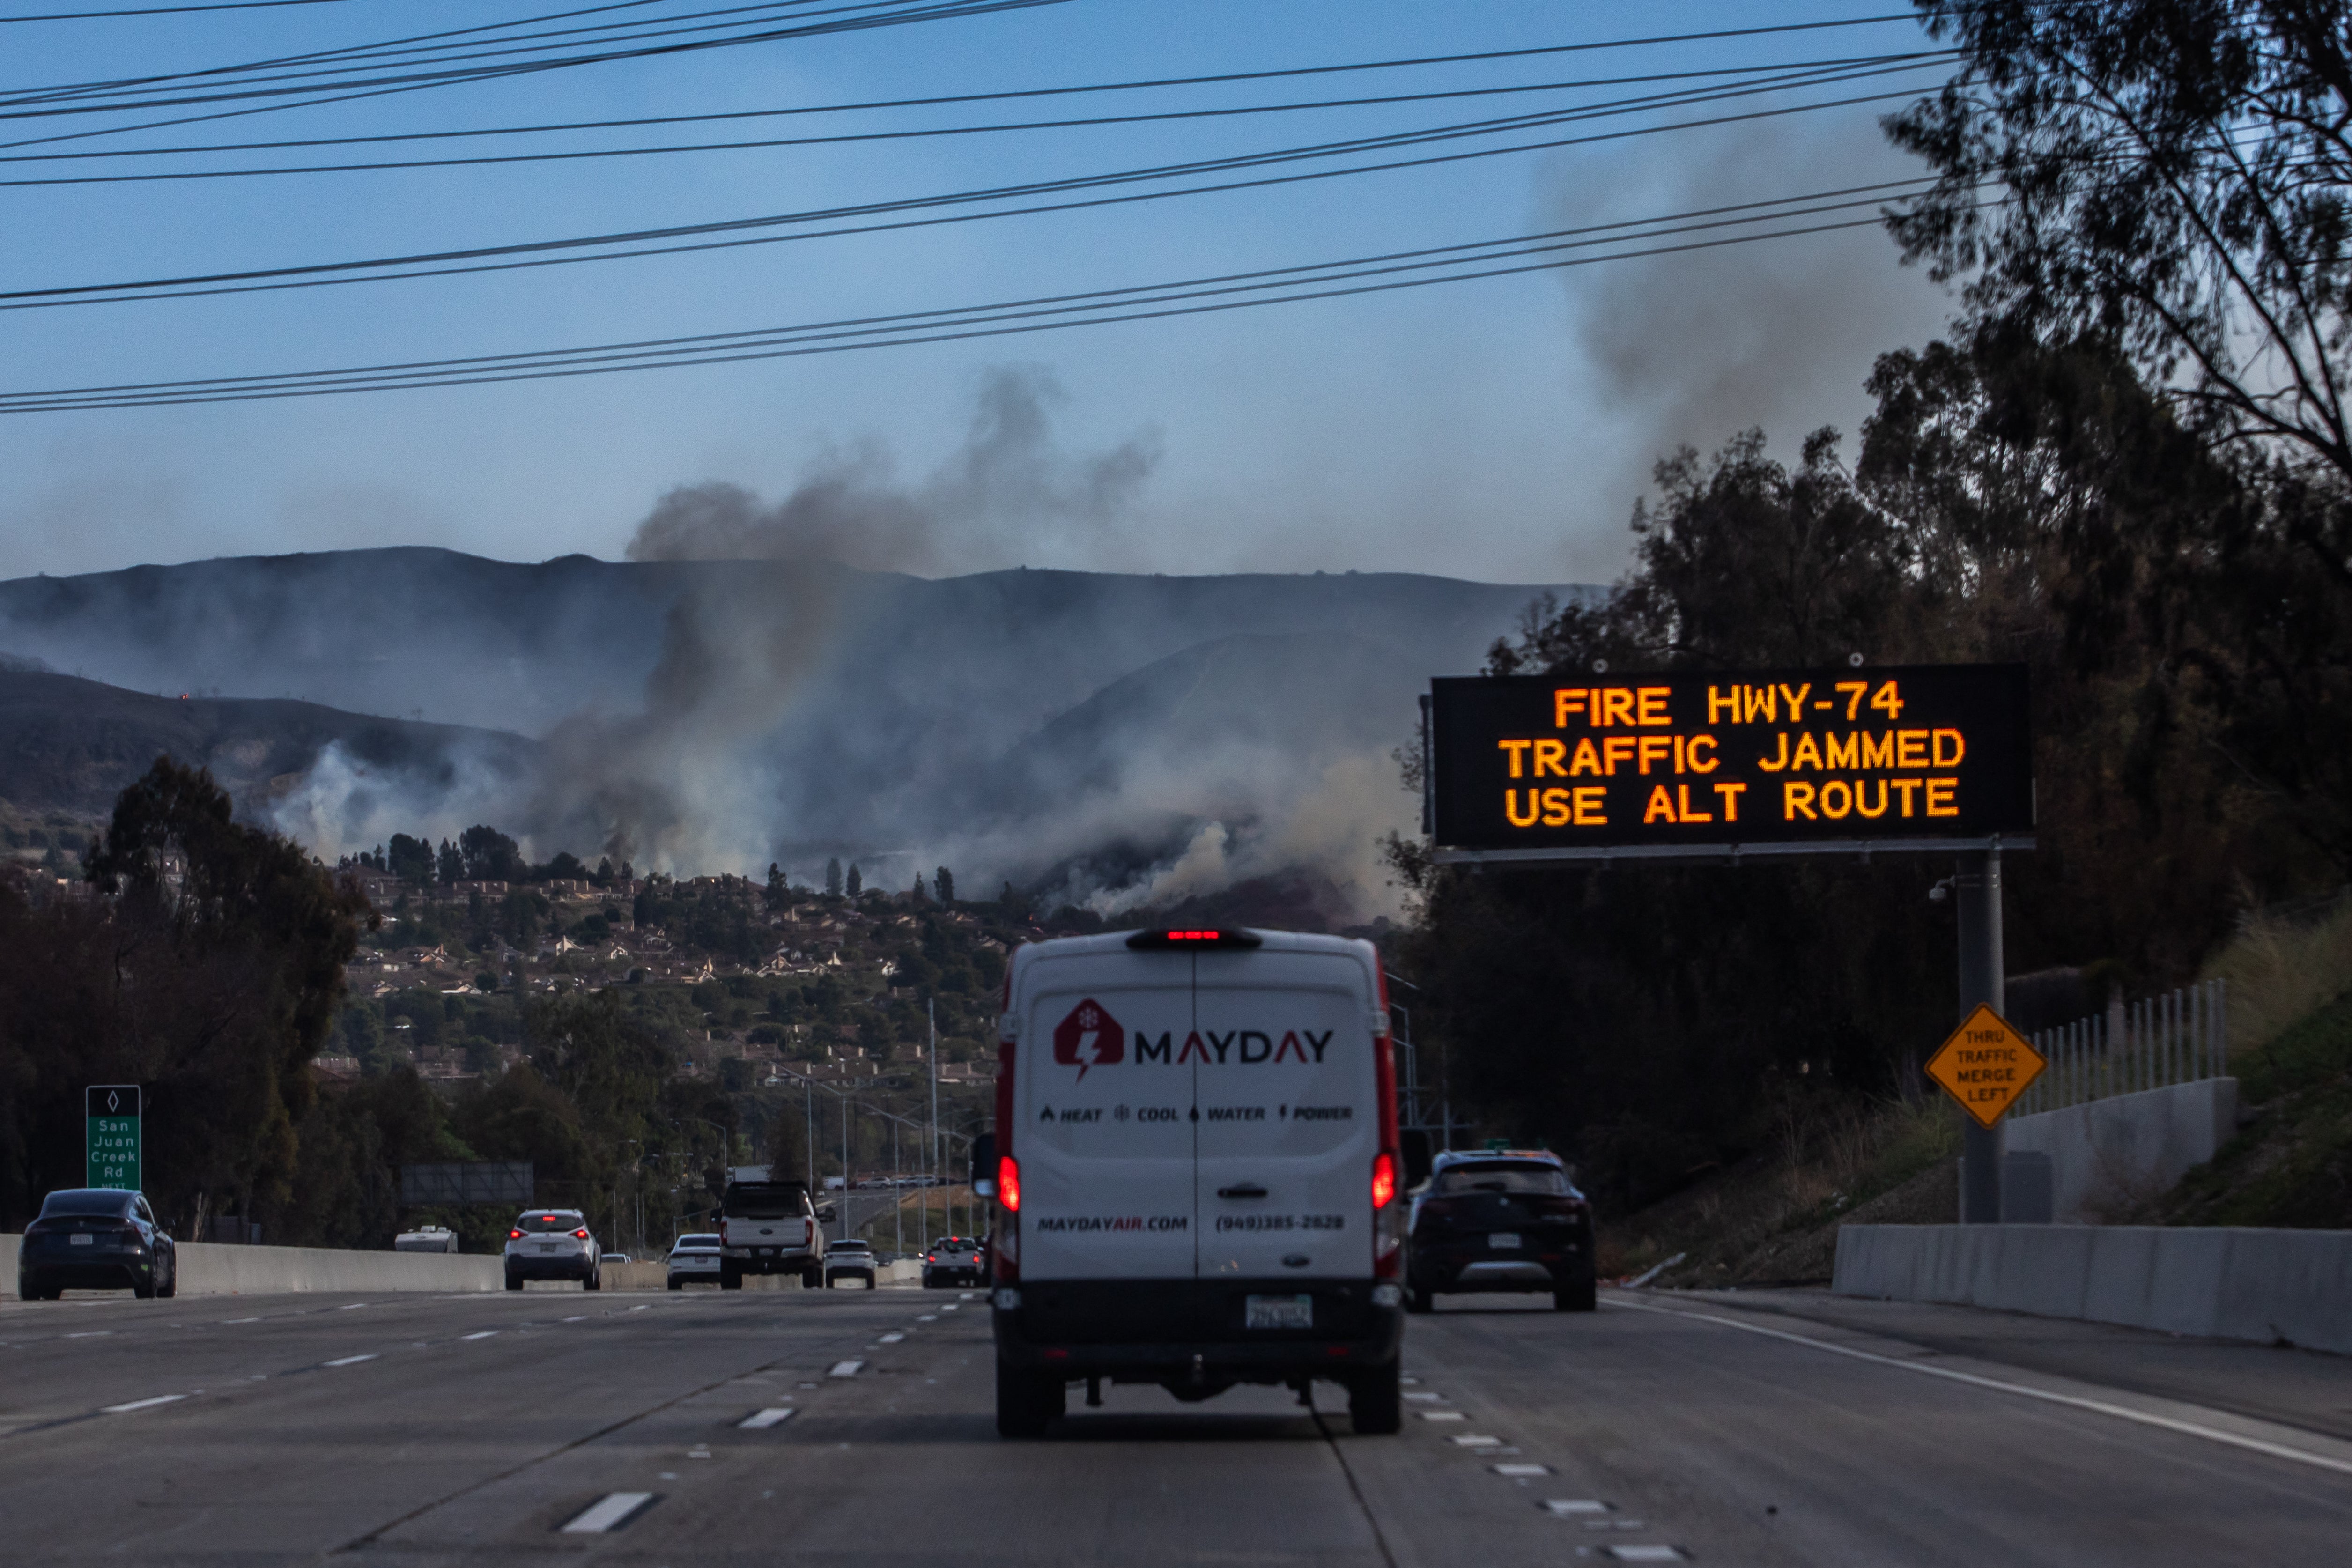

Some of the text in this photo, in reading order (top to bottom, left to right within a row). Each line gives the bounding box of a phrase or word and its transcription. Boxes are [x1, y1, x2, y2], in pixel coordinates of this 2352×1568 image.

[1555, 680, 1905, 727] FIRE HWY-74
[1498, 728, 1965, 778] TRAFFIC JAMMED
[1505, 777, 1960, 827] USE ALT ROUTE
[1966, 1030, 2004, 1043] THRU
[1135, 1030, 1334, 1065] MAYDAY
[1958, 1049, 2016, 1063] TRAFFIC
[1957, 1068, 2015, 1083] MERGE
[1967, 1087, 2009, 1102] LEFT
[1060, 1107, 1353, 1122] HEAT COOL WATER POWER
[99, 1120, 128, 1132] San
[94, 1136, 133, 1147] Juan
[91, 1151, 135, 1162] Creek
[104, 1166, 123, 1178] Rd
[1037, 1215, 1188, 1232] MAYDAYAIR.COM
